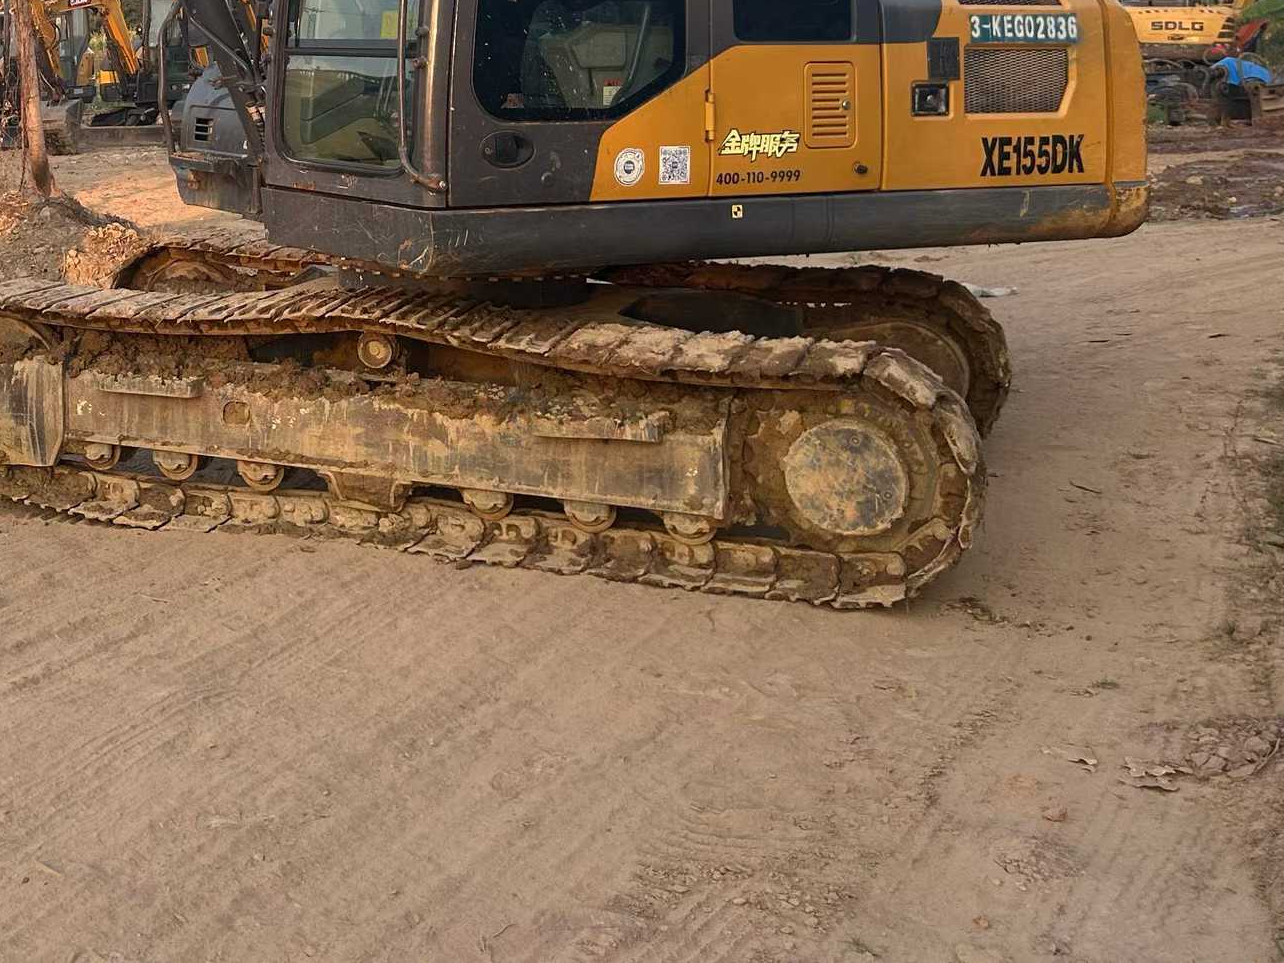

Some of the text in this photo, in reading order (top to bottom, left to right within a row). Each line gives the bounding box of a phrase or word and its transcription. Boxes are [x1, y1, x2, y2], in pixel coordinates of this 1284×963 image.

[1151, 21, 1204, 31] SDLG
[718, 128, 801, 163] 金牌服务
[980, 134, 1085, 177] XE155DK
[716, 170, 801, 185] 400-110-9999
